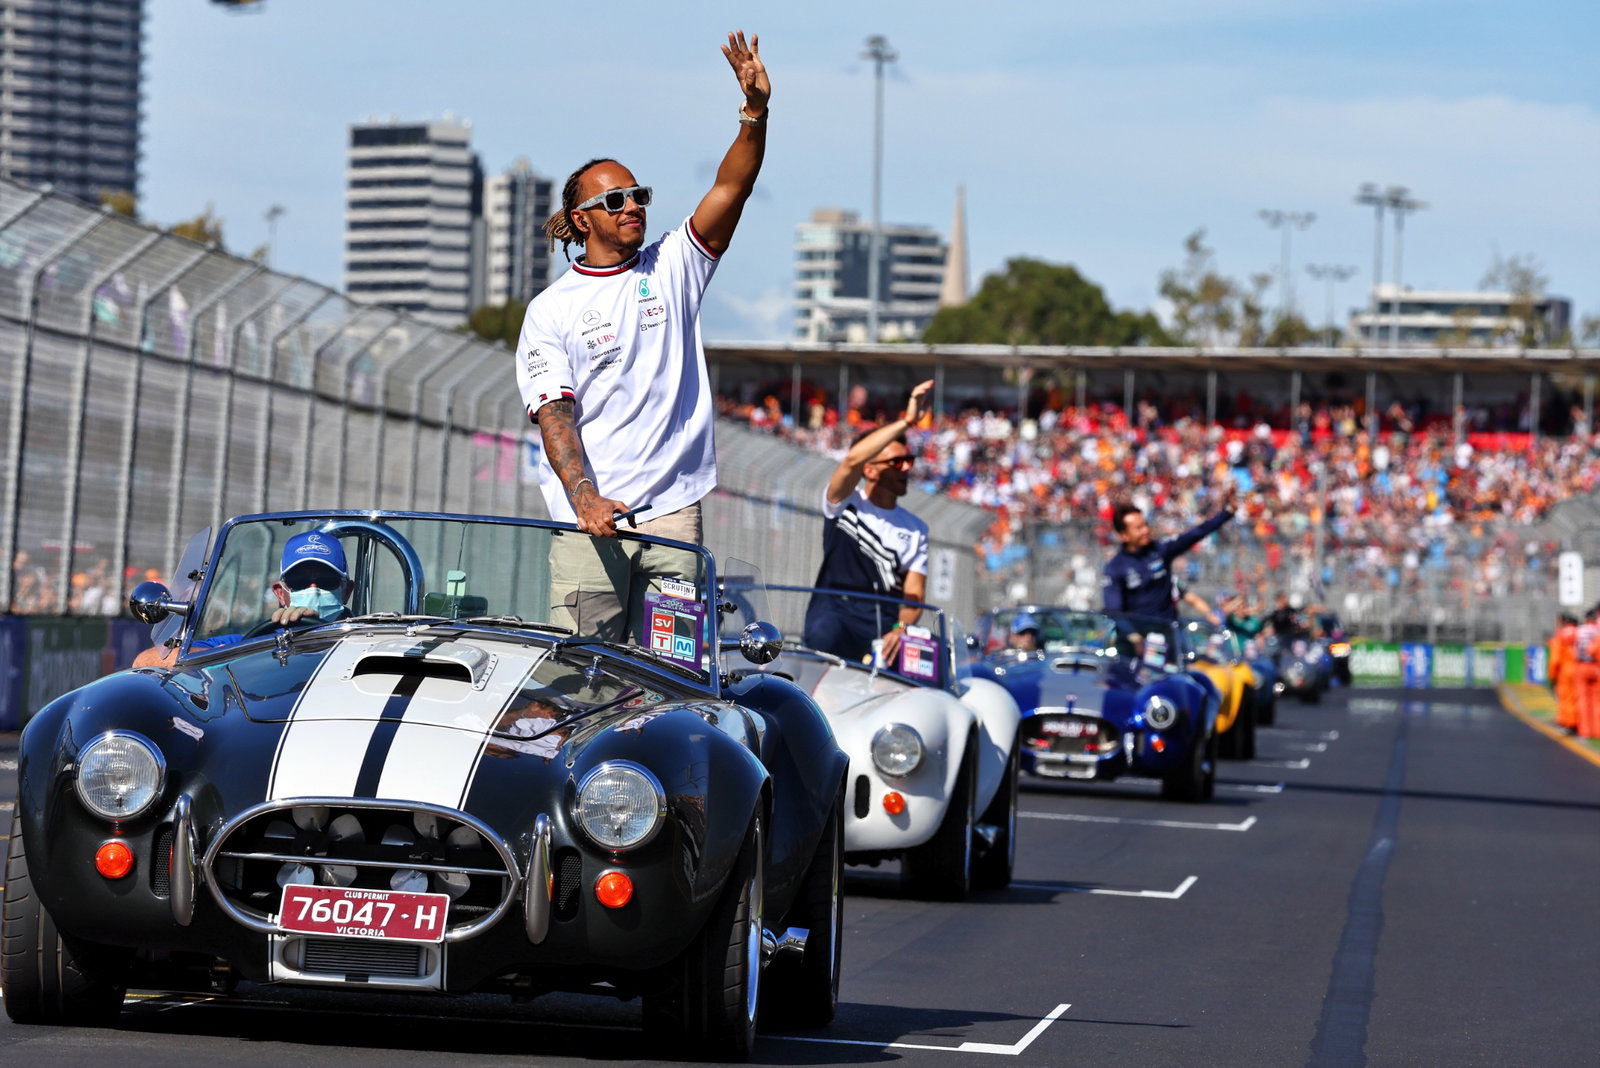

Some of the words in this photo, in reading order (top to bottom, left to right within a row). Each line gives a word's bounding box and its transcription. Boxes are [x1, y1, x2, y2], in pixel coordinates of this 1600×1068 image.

[639, 305, 665, 319] INEOS
[596, 333, 616, 345] UBS
[663, 582, 695, 594] SCRUTINY
[655, 618, 672, 628] SV
[656, 635, 669, 647] T
[676, 640, 691, 653] M
[344, 890, 363, 900] CLUB
[363, 891, 390, 901] PERMIT
[336, 926, 386, 937] VICTORIA
